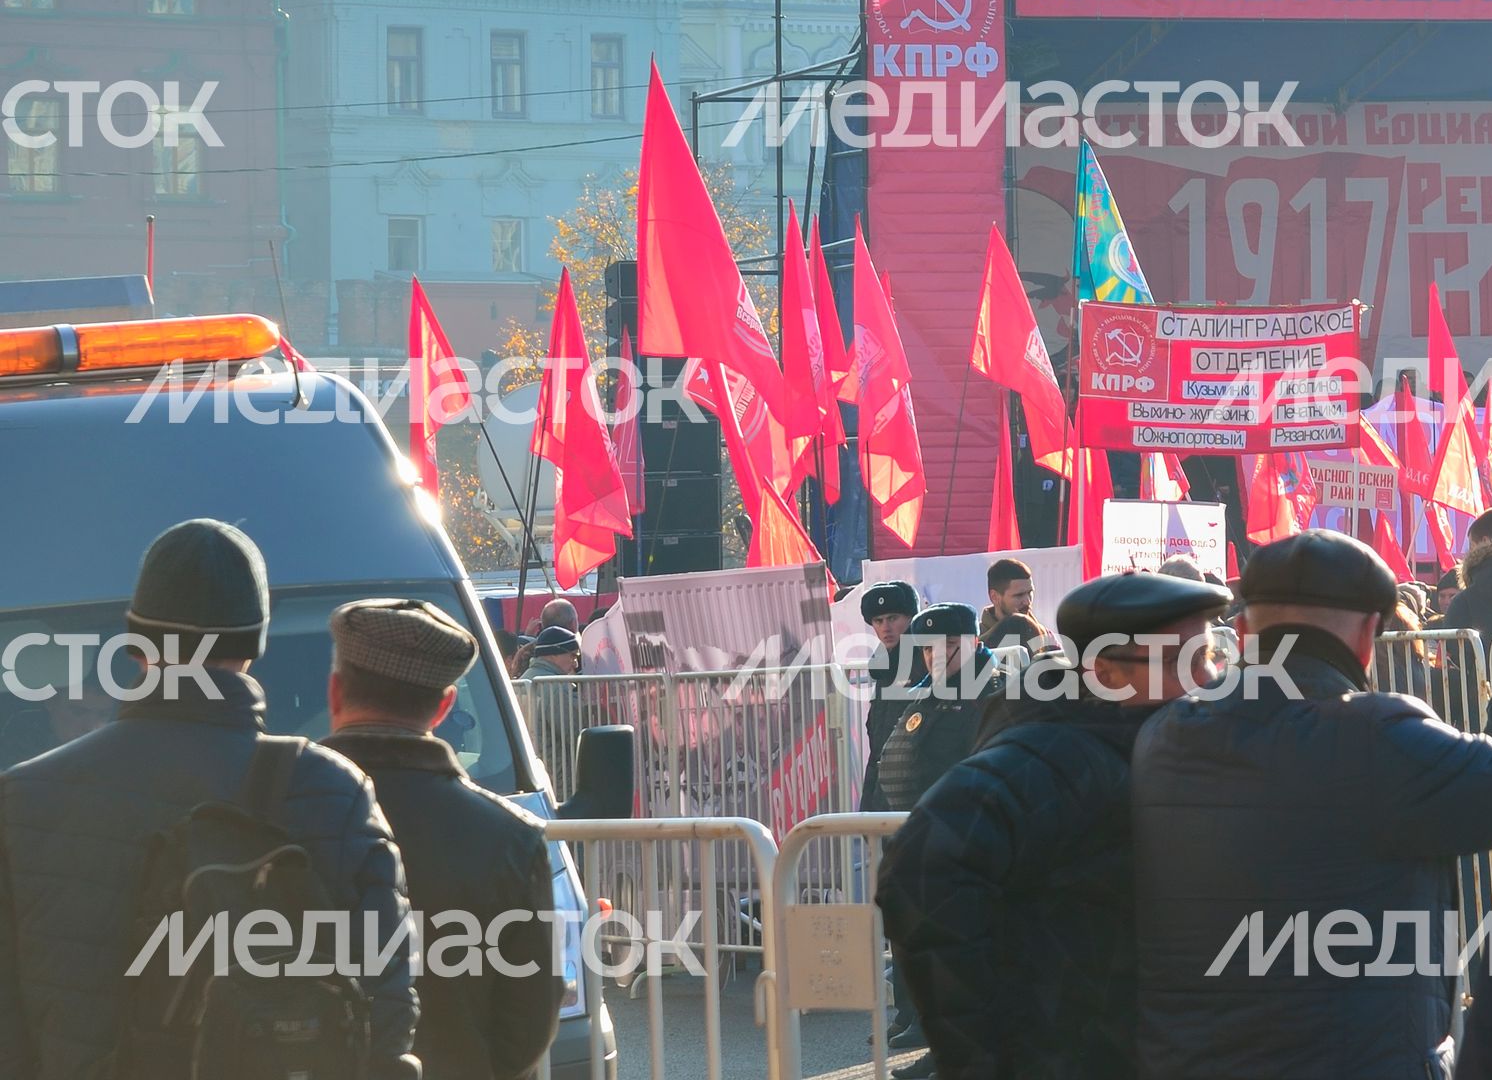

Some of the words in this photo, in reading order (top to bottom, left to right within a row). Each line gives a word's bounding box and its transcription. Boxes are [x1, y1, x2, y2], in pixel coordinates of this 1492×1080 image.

[873, 41, 998, 78] КПРФ
[1168, 176, 1389, 306] 1917
[1161, 309, 1353, 340] СТАЛИНГРАДСКОЕ
[1195, 347, 1323, 372] ОТДЕЛЕНИЕ
[1091, 372, 1155, 393] КПРФ
[1330, 484, 1366, 502] РАЙН
